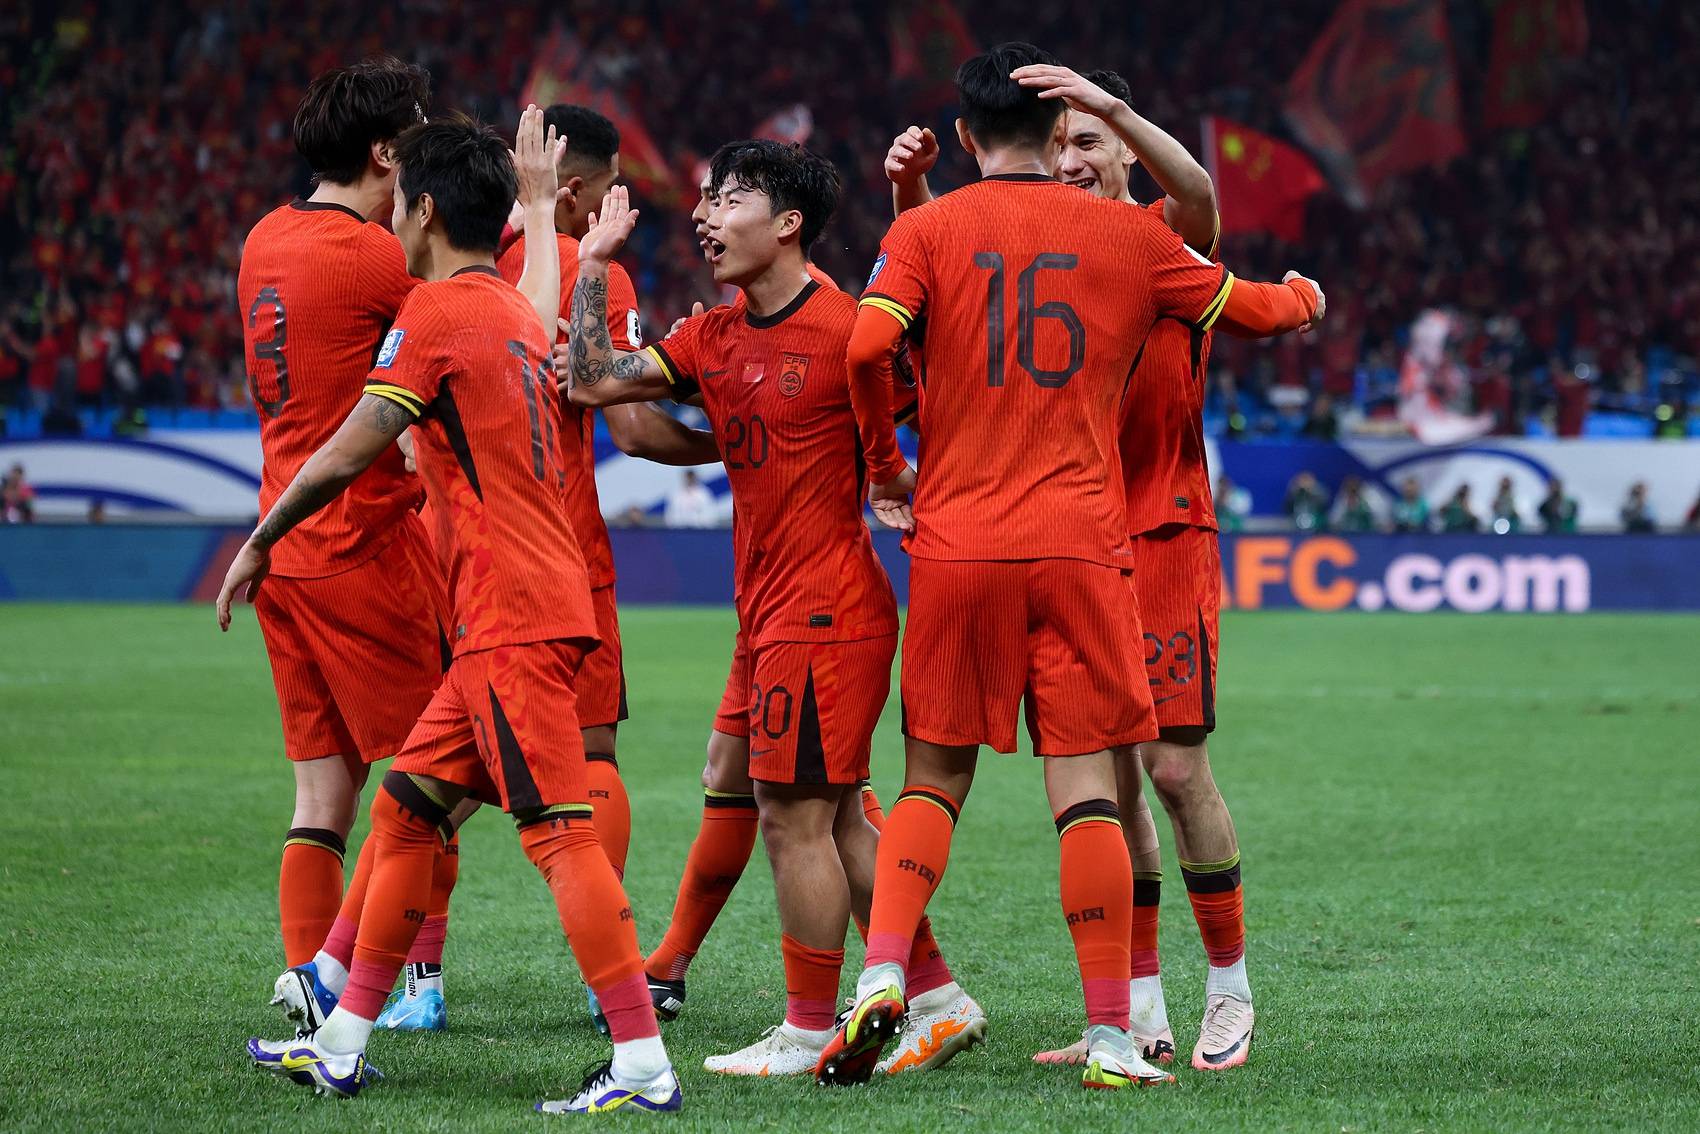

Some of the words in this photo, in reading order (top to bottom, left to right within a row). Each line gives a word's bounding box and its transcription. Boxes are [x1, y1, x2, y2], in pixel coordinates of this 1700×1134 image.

[973, 251, 1086, 388] 16
[248, 286, 290, 419] 3
[725, 415, 768, 469] 20
[1220, 537, 1591, 612] FC.com
[1143, 631, 1196, 684] 23
[898, 859, 936, 886] 中国
[1067, 906, 1105, 926] 中国
